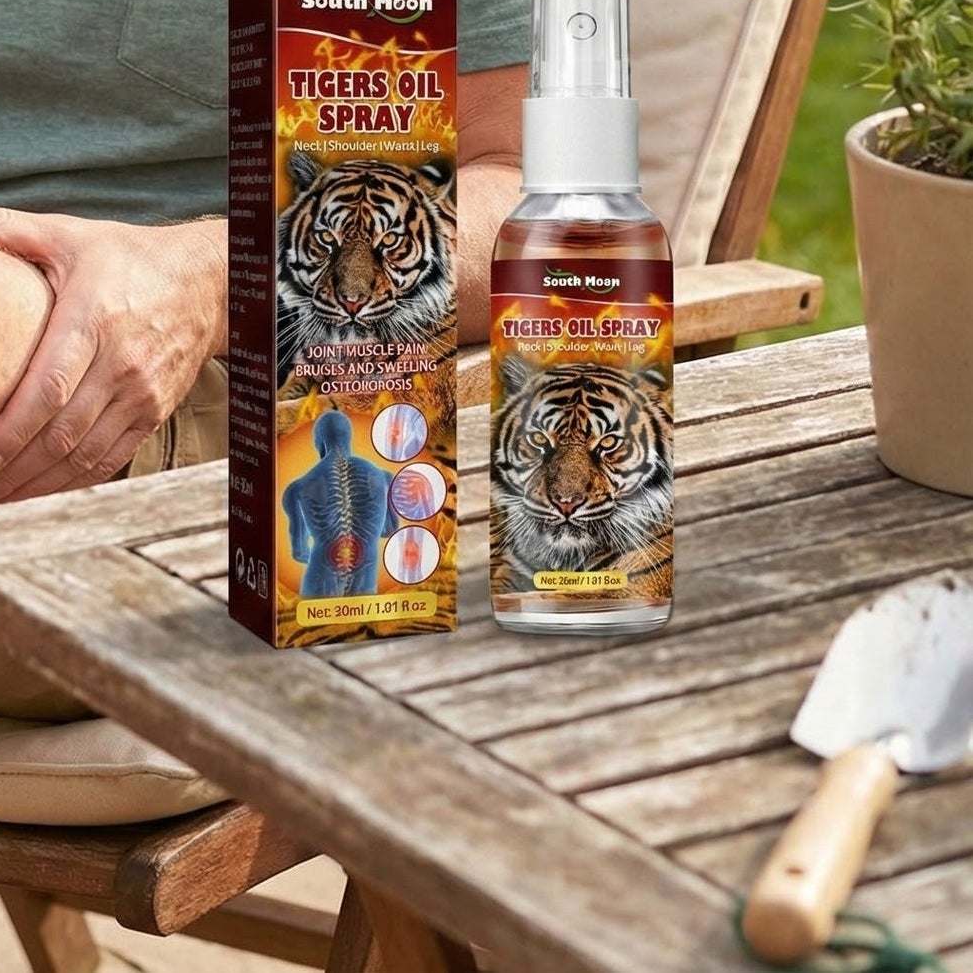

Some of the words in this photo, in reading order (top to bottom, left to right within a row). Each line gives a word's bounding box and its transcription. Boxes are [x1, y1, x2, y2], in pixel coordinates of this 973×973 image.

[289, 69, 389, 100] TIGERS
[397, 70, 444, 101] OIL
[318, 102, 416, 134] SPRAY
[543, 275, 581, 288] South
[502, 318, 564, 338] TIGERS
[567, 317, 597, 338] OIL
[600, 318, 661, 338] SPRAY
[307, 345, 343, 359] JOINT
[346, 343, 395, 358] MUSCLE
[348, 362, 374, 375] AND
[412, 601, 427, 611] oz
